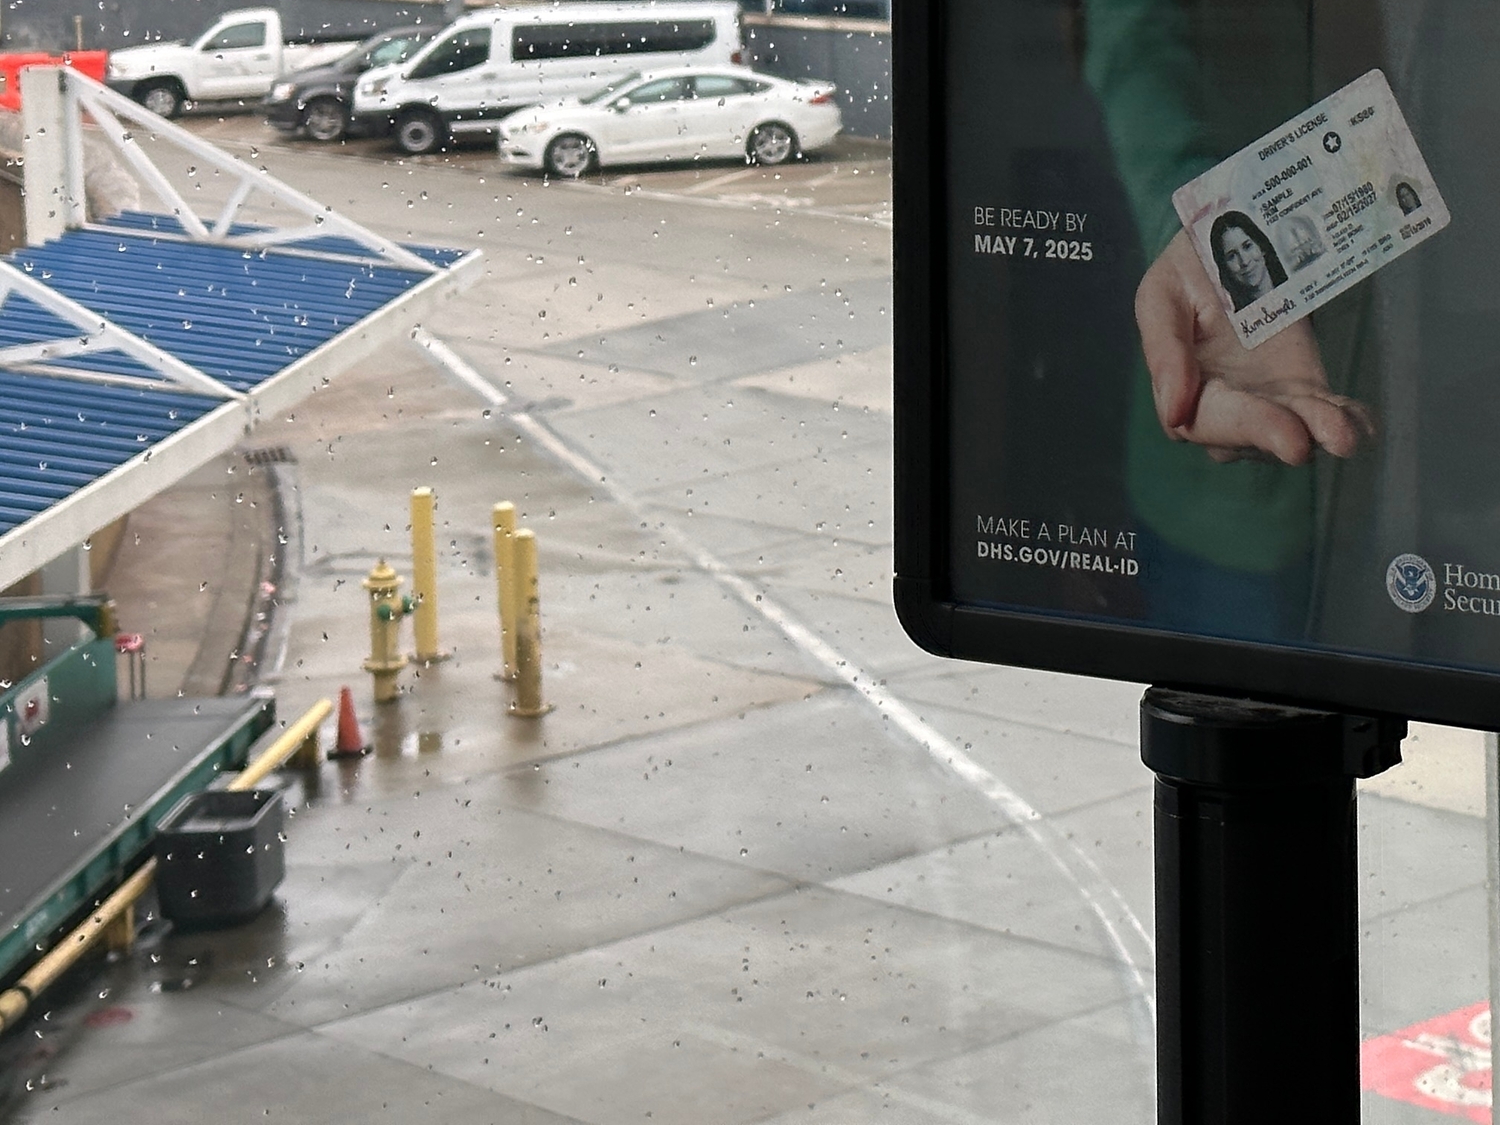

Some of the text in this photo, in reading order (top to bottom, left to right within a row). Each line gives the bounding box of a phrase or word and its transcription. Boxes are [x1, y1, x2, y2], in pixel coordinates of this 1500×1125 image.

[1258, 132, 1296, 161] DRIVER'S
[1294, 112, 1328, 138] LICENSE
[1262, 187, 1294, 211] SAMPLE
[974, 206, 1088, 233] BE READY BY
[974, 234, 1094, 261] MAY 7, 2025
[1240, 316, 1264, 339] Kim
[977, 514, 1138, 551] MAKE A PLAN AT
[977, 540, 1140, 576] DHS.GOV/REAL-ID
